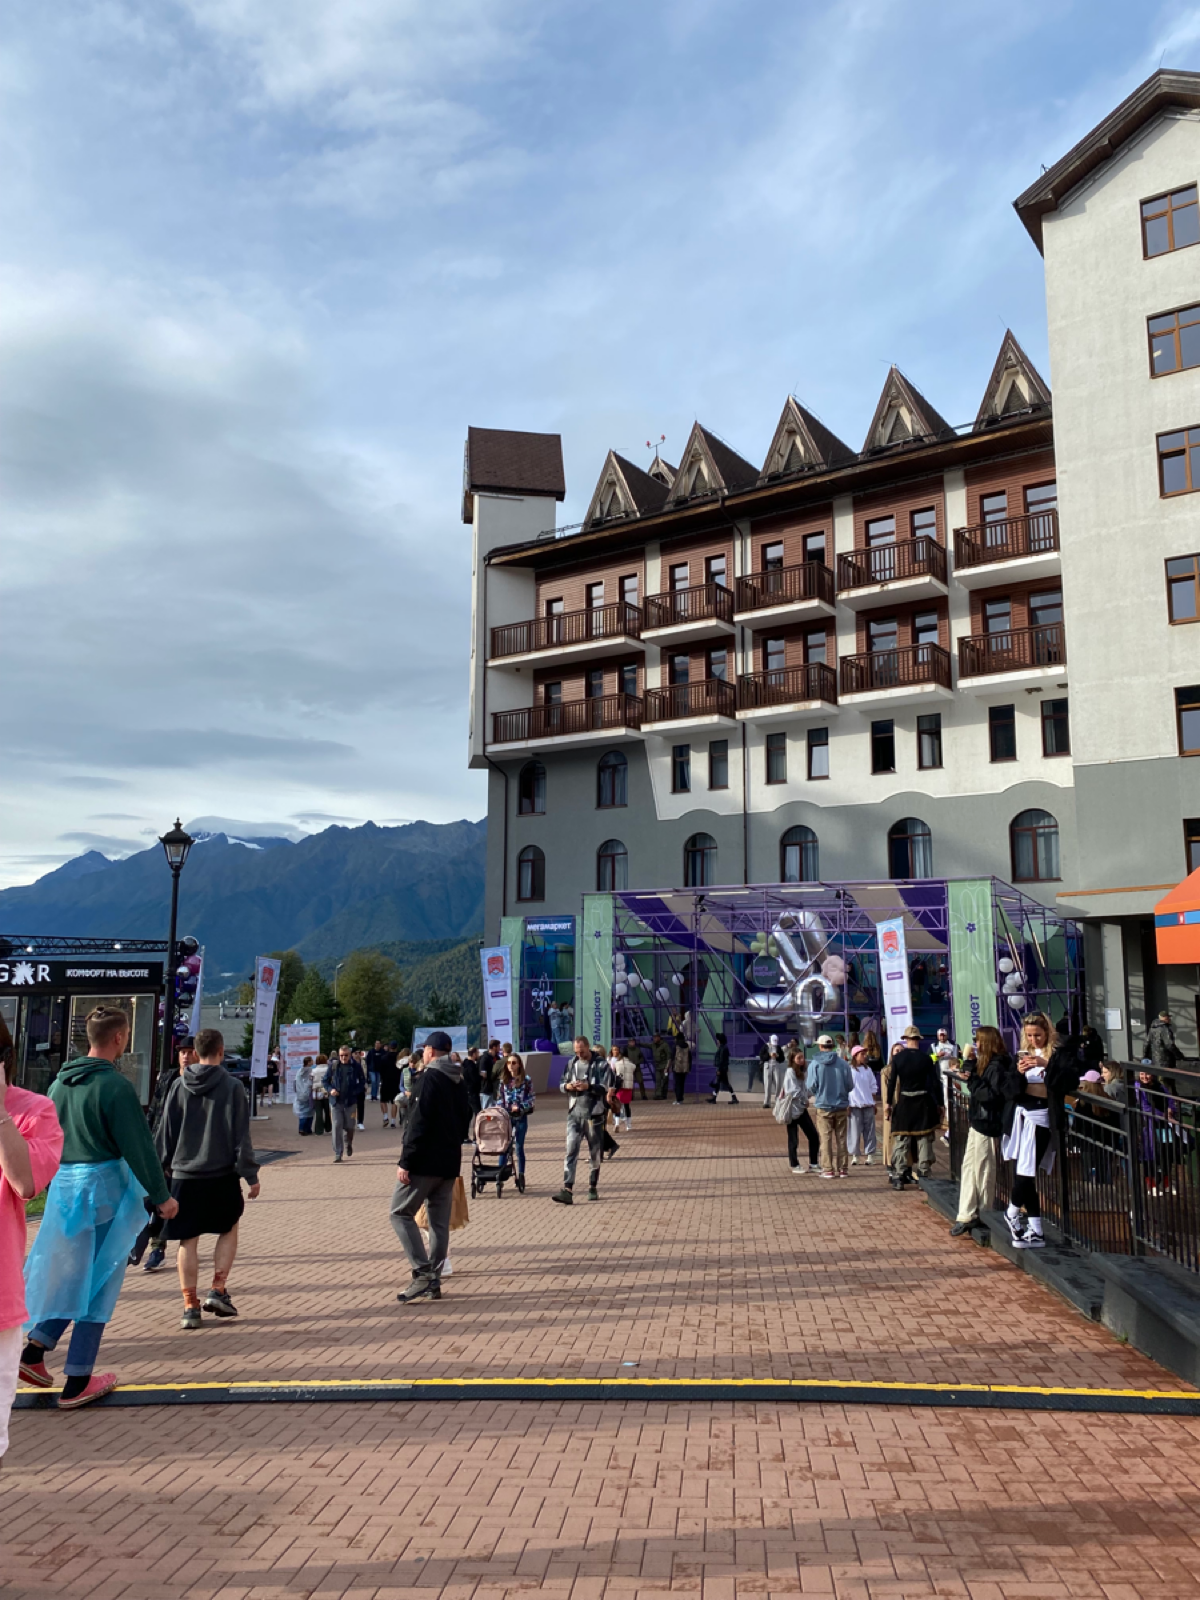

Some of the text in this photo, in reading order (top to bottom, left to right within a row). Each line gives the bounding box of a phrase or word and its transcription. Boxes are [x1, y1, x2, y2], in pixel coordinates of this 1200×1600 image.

[527, 923, 571, 931] мегамаркет
[66, 969, 149, 977] КОМФОРТ НА ВЫСОТЕ
[593, 990, 603, 1046] гамаркет
[969, 994, 983, 1036] аркет
